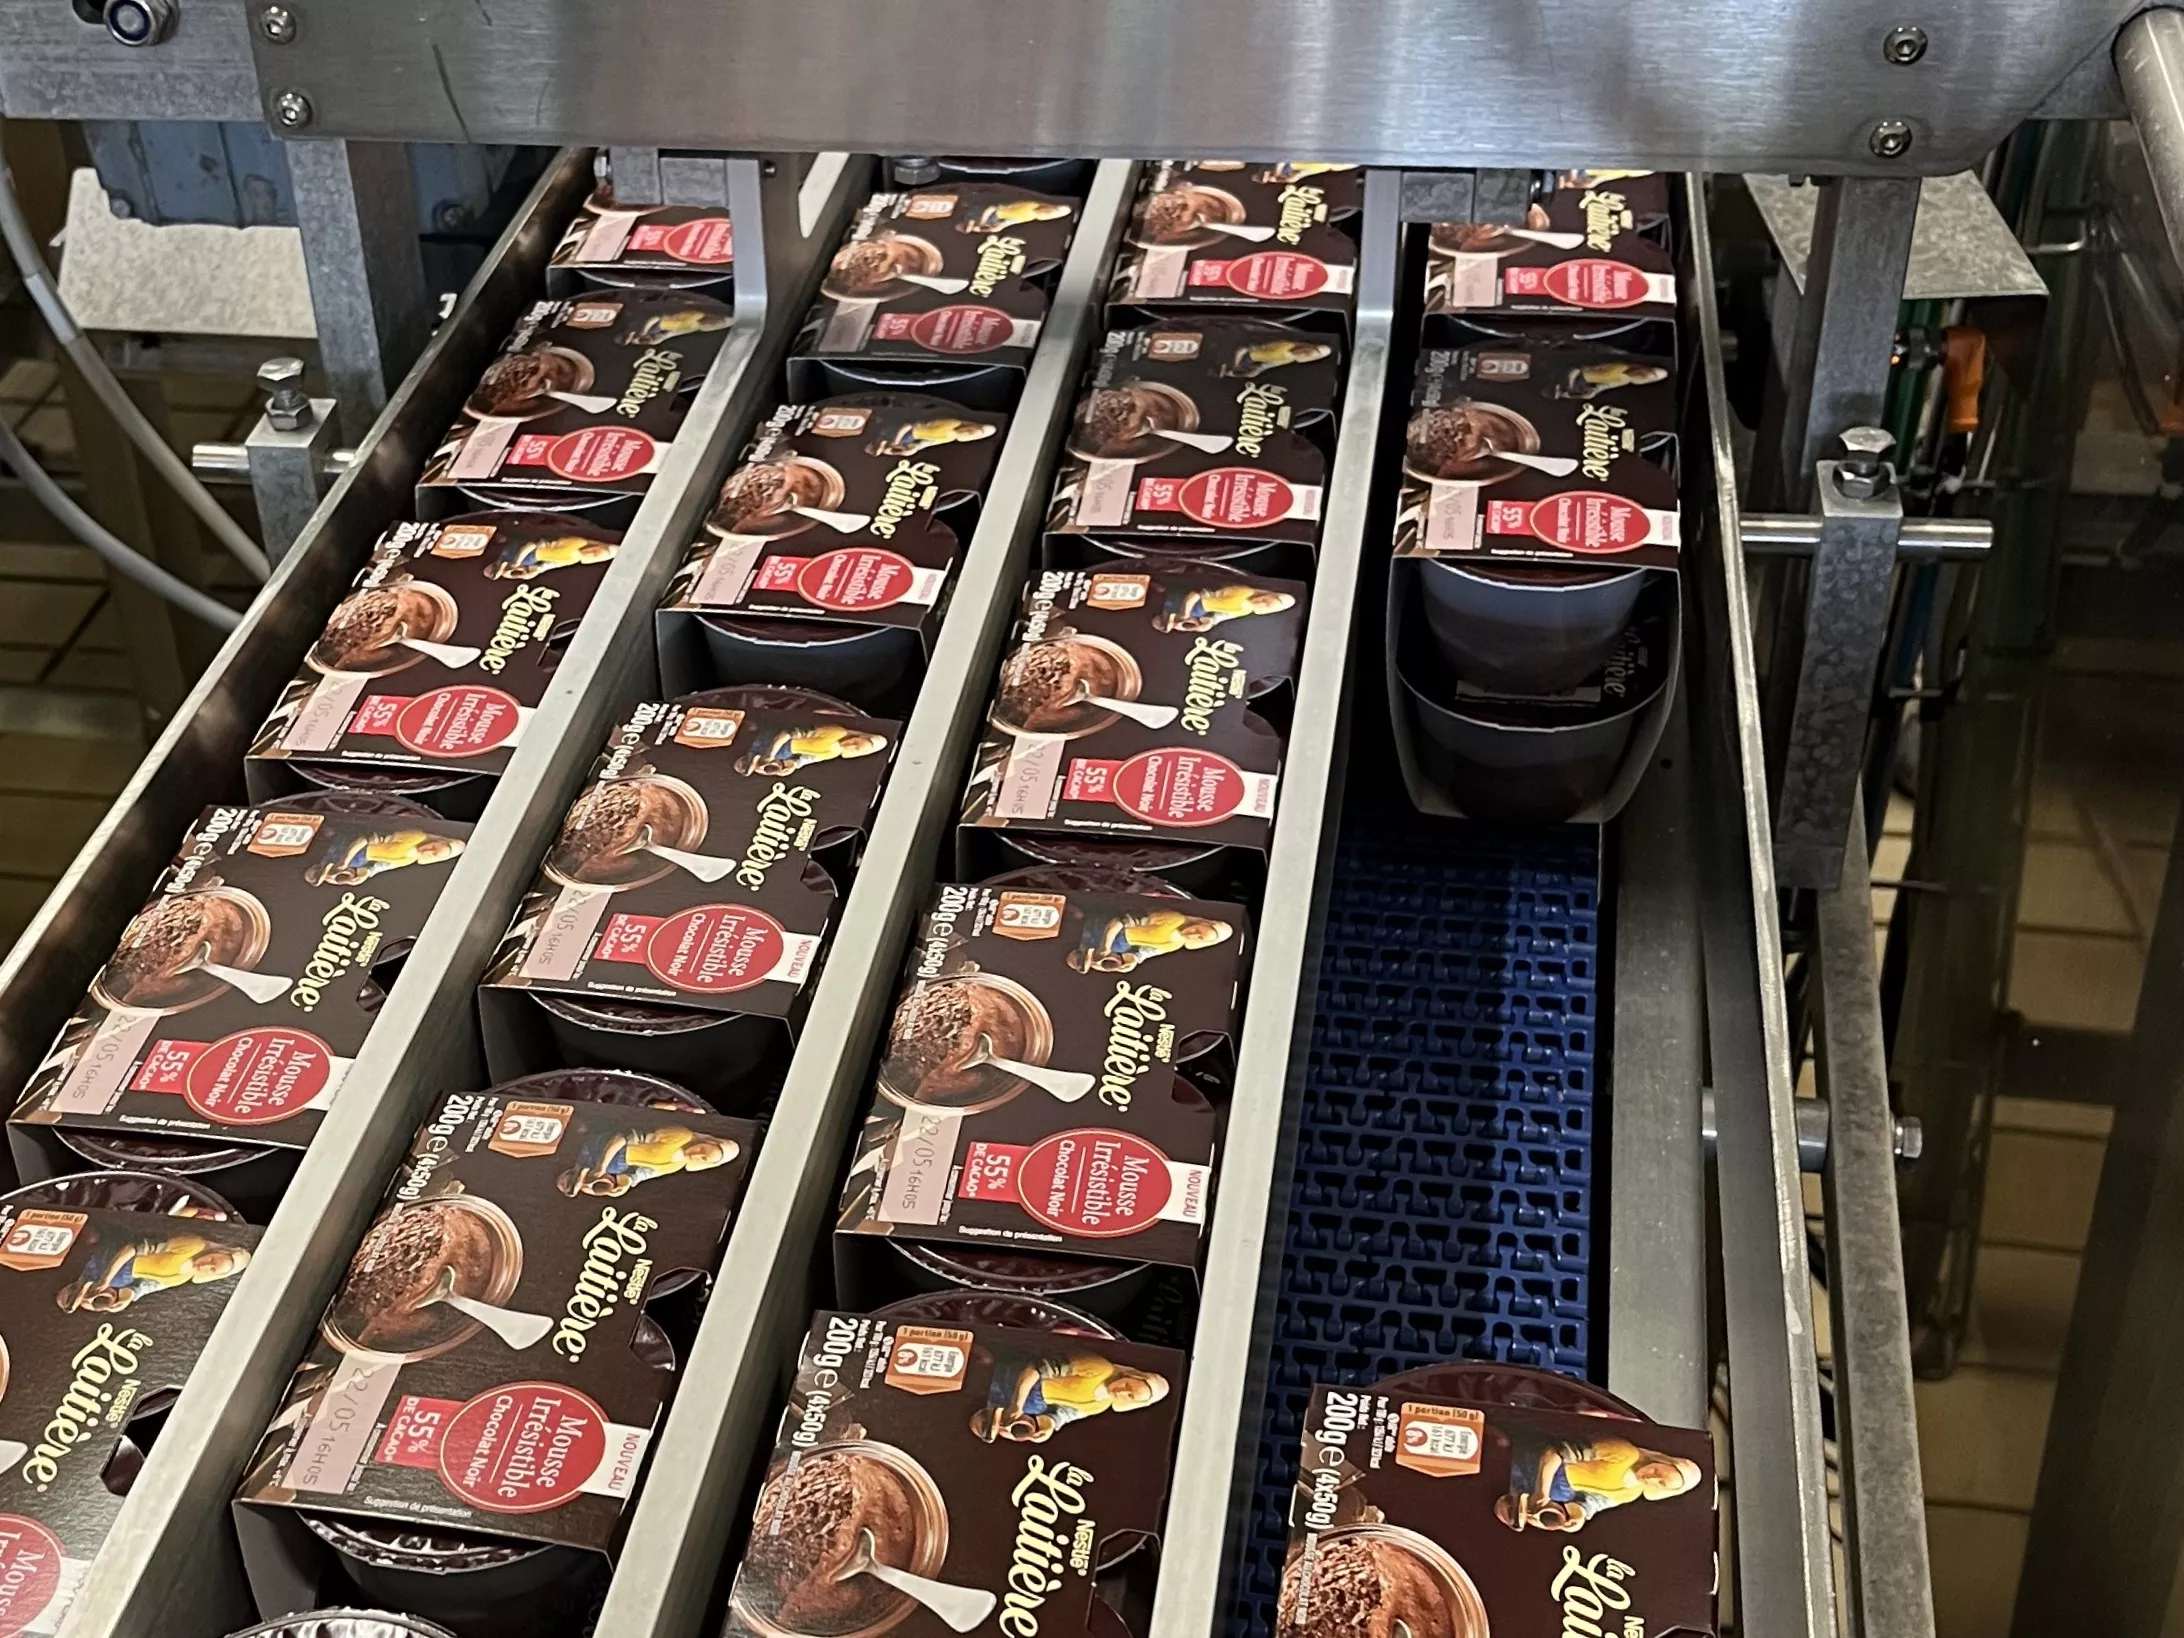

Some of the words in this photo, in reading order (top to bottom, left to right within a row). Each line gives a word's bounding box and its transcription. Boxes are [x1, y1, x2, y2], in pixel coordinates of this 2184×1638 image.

[479, 584, 550, 669] Laitière
[736, 782, 810, 885] Laitière
[930, 885, 968, 922] 200g
[290, 892, 377, 1006] Laitière
[726, 926, 768, 976] Mousse
[1148, 988, 1172, 1002] la
[215, 1036, 255, 1083] Chocolat
[1098, 980, 1165, 1105] Laitière
[1154, 1023, 1175, 1058] Nestlé
[157, 1050, 190, 1082] 55%
[232, 1037, 295, 1114] Irrésistible
[265, 1050, 316, 1105] Mousse
[202, 1083, 229, 1107] Noir
[427, 1093, 475, 1136] 200g
[973, 1142, 987, 1157] DE
[982, 1153, 1011, 1189] 55%
[1050, 1139, 1076, 1190] Chocolat
[1045, 1191, 1066, 1218] Noir
[1080, 1140, 1120, 1225] Irrésistible
[1114, 1155, 1149, 1215] Mousse
[1182, 1169, 1201, 1217] NOUVEAU
[631, 1216, 658, 1232] la
[552, 1206, 645, 1354] Laitière
[621, 1257, 653, 1299] Nestlé
[125, 1332, 152, 1350] la
[812, 1315, 859, 1368] 200g
[23, 1322, 136, 1484] Laitière
[102, 1378, 142, 1423] Nestlé
[401, 1396, 420, 1413] DE
[473, 1394, 515, 1456] Chocolat
[1314, 1389, 1358, 1445] 200g
[405, 1409, 441, 1452] 55%
[495, 1395, 562, 1498] Irrésistible
[534, 1414, 588, 1487] Mousse
[460, 1456, 489, 1488] Noir
[606, 1432, 640, 1491] NOUVEAU
[1064, 1466, 1094, 1487] la
[998, 1454, 1084, 1638] Laitière
[1068, 1518, 1096, 1570] Nestlé
[1605, 1558, 1636, 1581] la
